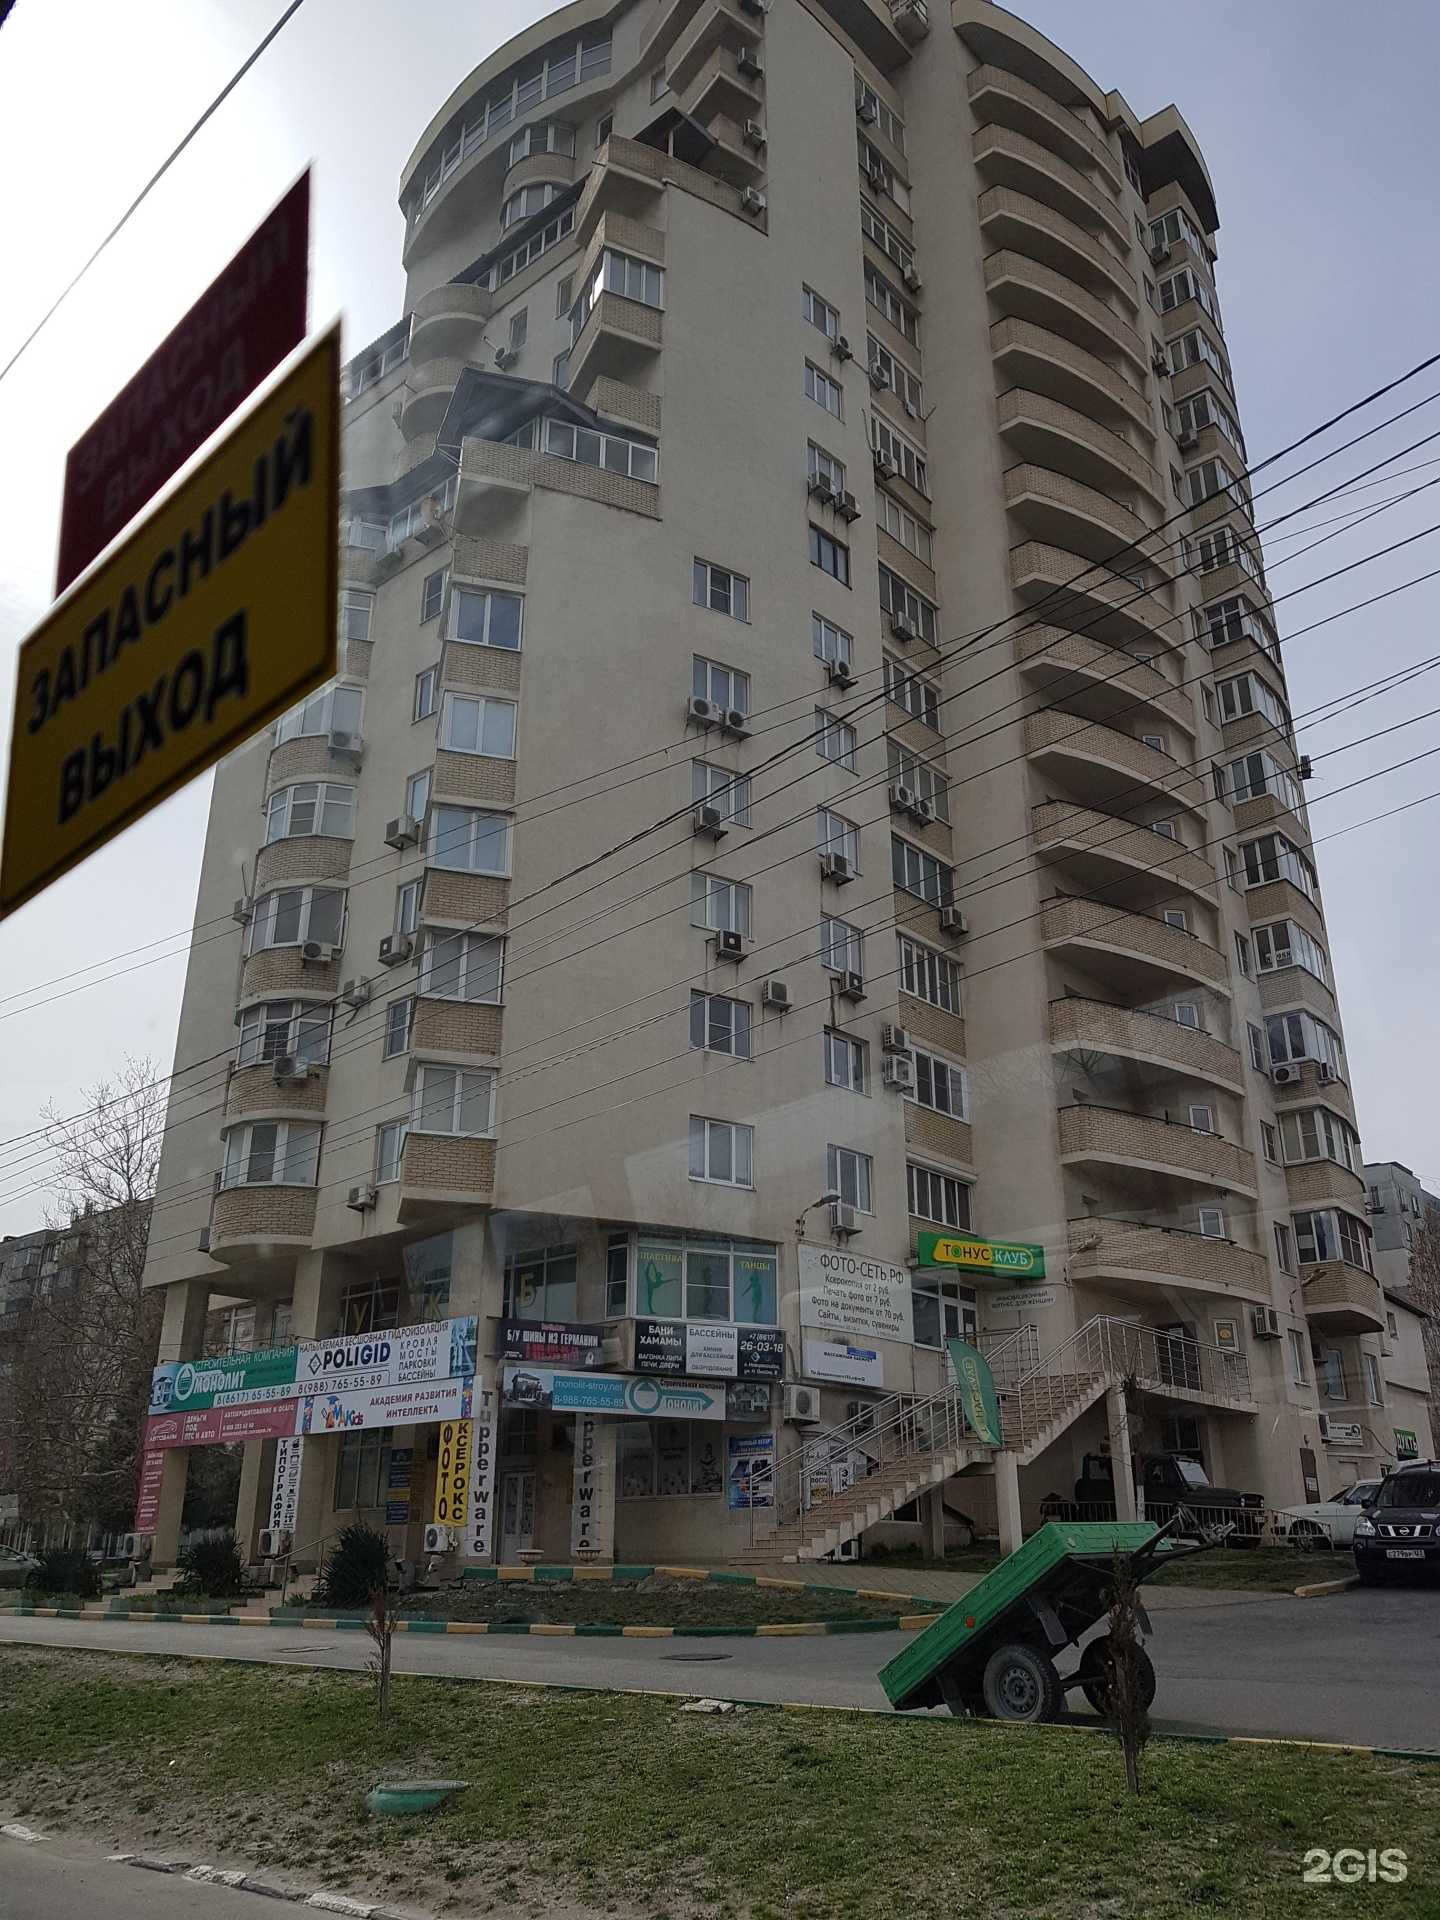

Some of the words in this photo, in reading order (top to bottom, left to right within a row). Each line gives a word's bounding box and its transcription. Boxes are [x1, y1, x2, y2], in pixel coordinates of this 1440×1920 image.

[27, 406, 313, 736] ЗАПАСНЫЙ
[57, 608, 249, 825] ВЫХОД
[943, 1244, 991, 1261] ТОНУС
[994, 1250, 1028, 1265] КЛУБ
[820, 1254, 904, 1284] ФОТО-СЕТЬ.РФ
[823, 1286, 847, 1298] Печать
[848, 1291, 864, 1301] фото
[811, 1296, 829, 1307] Фото
[840, 1302, 875, 1315] документы
[884, 1310, 892, 1318] 70
[299, 1338, 344, 1353] НАПЫЛЯЕМАЯ
[344, 1331, 387, 1347] БЕСШОВНАЯ
[388, 1322, 449, 1341] ГИДРОИЗОЛЯЦИЯ
[507, 1329, 520, 1342] Б/У
[523, 1331, 546, 1343] ШИНЫ
[548, 1332, 559, 1344] ИЗ
[560, 1333, 598, 1347] ГЕРМАНИИ
[648, 1325, 674, 1335] БАНИ
[689, 1328, 735, 1339] БАССЕЙНЫ
[400, 1337, 438, 1350] КРОВЛЯ
[640, 1336, 682, 1346] ХАМАМЫ
[740, 1341, 784, 1352] 26-03-18
[194, 1354, 251, 1371] СТРОИТЕЛЬНАЯ
[253, 1345, 295, 1362] КОМПАНИЯ
[322, 1341, 391, 1370] POLIGID
[400, 1349, 438, 1360] МОСТЫ
[399, 1358, 437, 1371] ПАРКОВКИ
[659, 1362, 680, 1370] ДВЕРИ
[193, 1371, 247, 1393] МОНОЛИТ
[297, 1379, 329, 1395] 8(988)
[332, 1374, 382, 1390] 765-55-89
[398, 1369, 436, 1383] БАССЕЙНЫ
[369, 1393, 413, 1407] АКАДЕМИЯ
[415, 1388, 457, 1402] РАЗВИТИЯ
[186, 1415, 207, 1424] ДЕНЬГИ
[386, 1405, 439, 1419] ИНТЕЛЛЕКТА
[185, 1423, 198, 1432] ПОД
[200, 1430, 216, 1439] АВТО
[438, 1423, 454, 1520] ФОТО
[452, 1422, 469, 1521] КСЕРОКС
[473, 1390, 494, 1553] Tupperware
[272, 1439, 289, 1529] ТИПОГРАФИЯ
